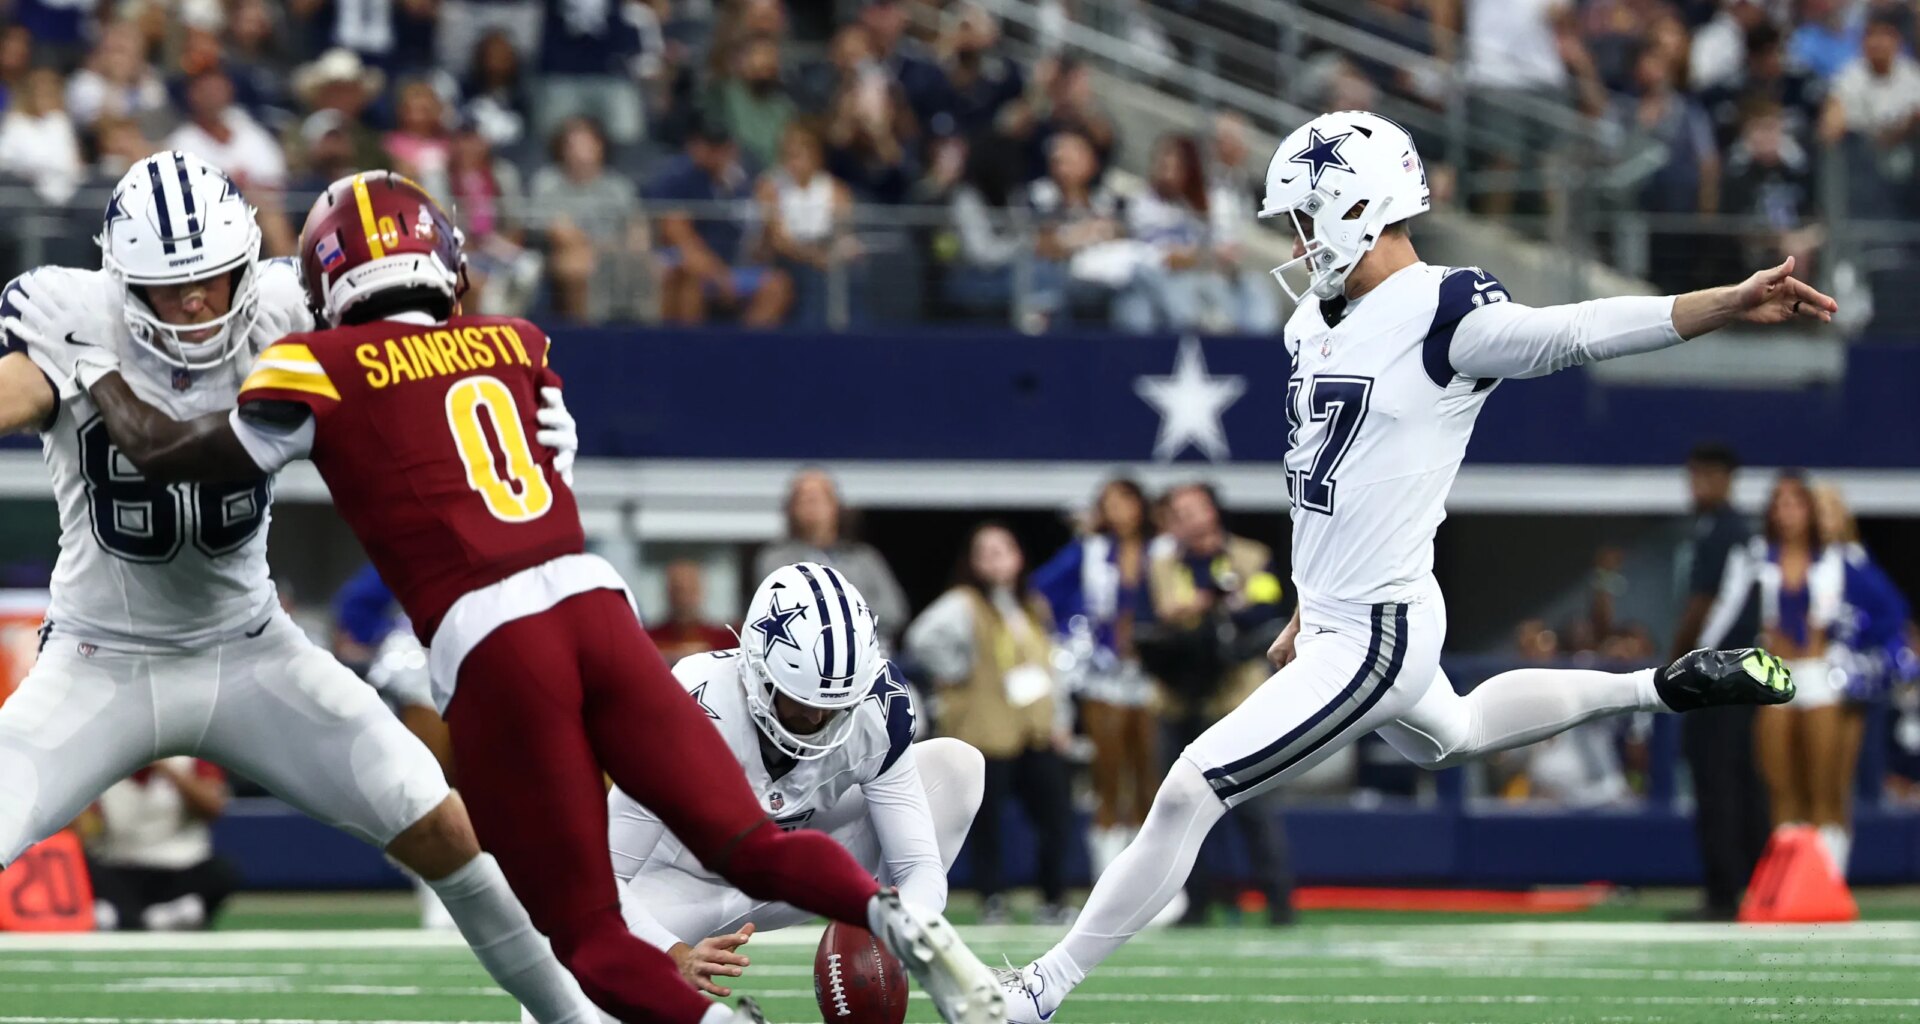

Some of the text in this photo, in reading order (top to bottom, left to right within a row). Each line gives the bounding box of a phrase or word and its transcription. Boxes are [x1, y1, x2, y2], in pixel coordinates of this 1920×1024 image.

[378, 216, 399, 249] 0
[169, 254, 204, 268] COWBOYS
[445, 375, 553, 523] 0
[10, 848, 80, 918] 20
